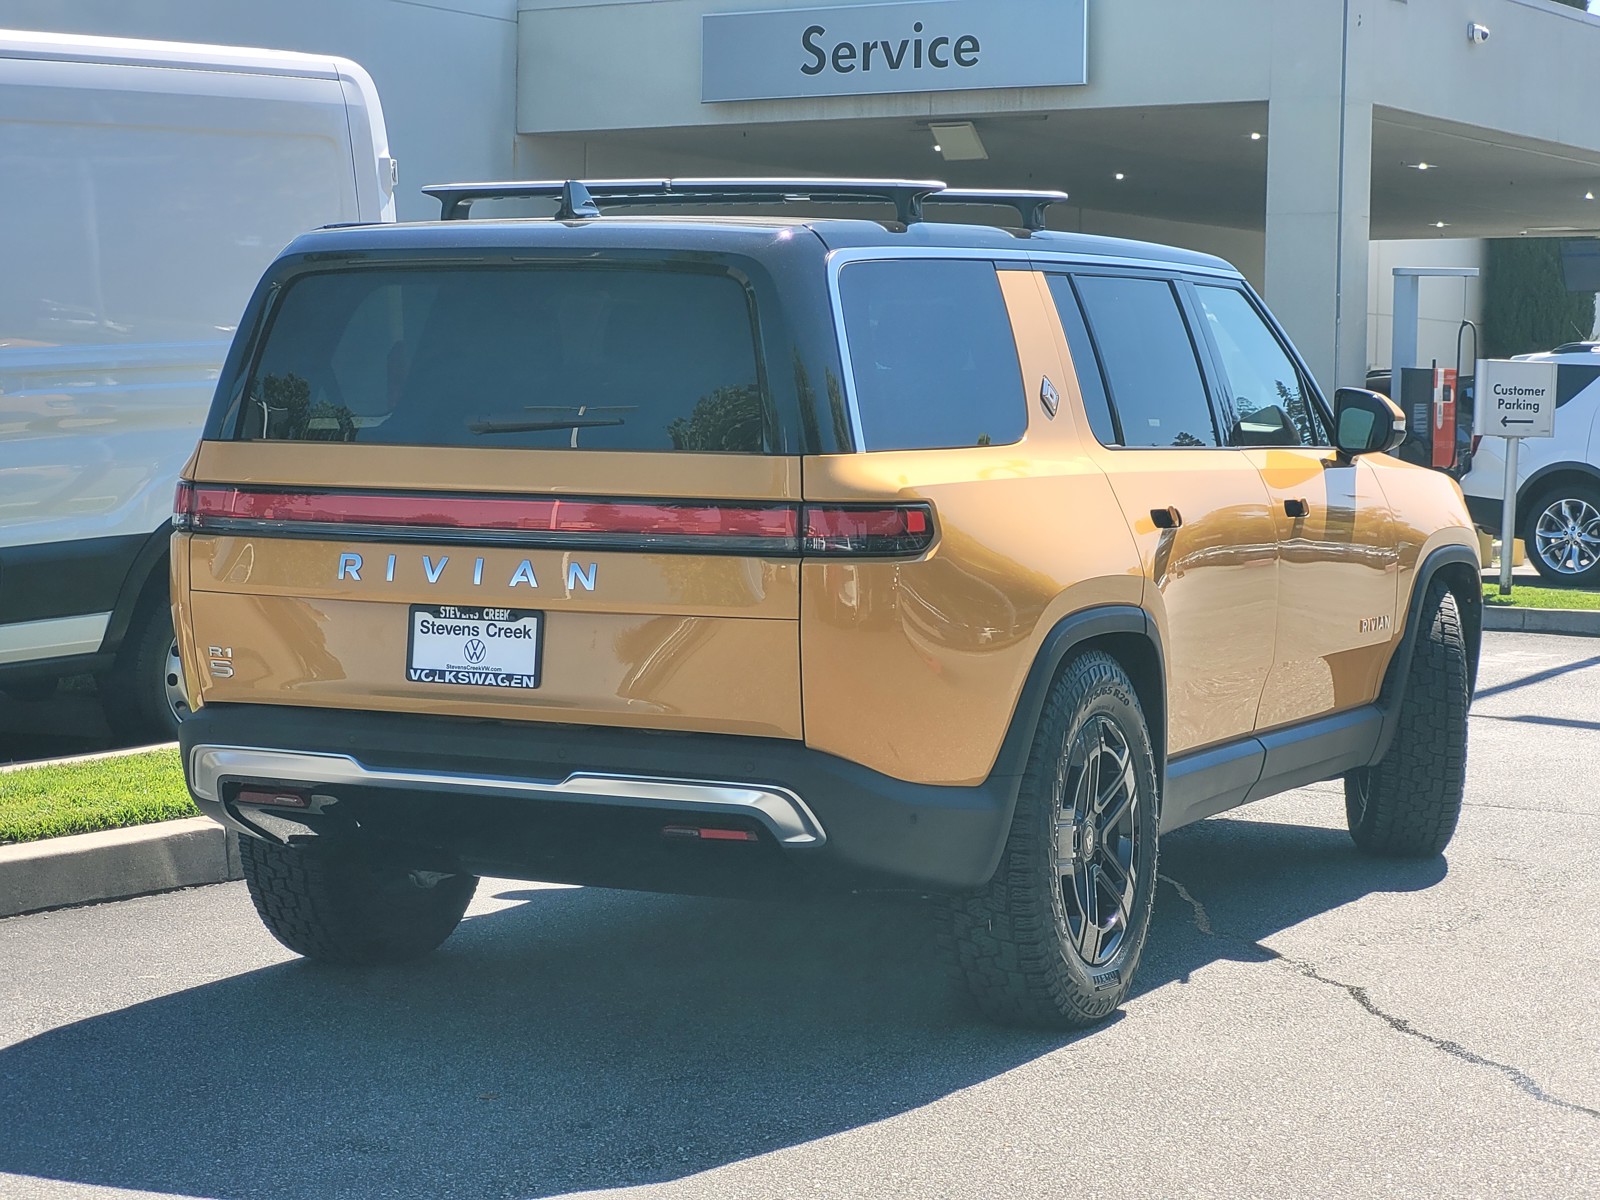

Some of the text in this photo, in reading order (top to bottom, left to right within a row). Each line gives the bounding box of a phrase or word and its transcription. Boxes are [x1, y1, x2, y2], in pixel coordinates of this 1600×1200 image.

[800, 21, 980, 76] Service
[1493, 383, 1546, 397] Customer
[1497, 398, 1540, 414] Parking
[337, 553, 598, 592] RIVIAN
[483, 608, 511, 621] CREEK
[420, 619, 533, 639] Stevens Creek
[1360, 615, 1391, 632] RIVIAN
[208, 646, 233, 658] R1
[446, 663, 503, 672] StevensCreekVW.com
[410, 669, 535, 688] VOLKSWAGEN
[1113, 688, 1130, 706] R20
